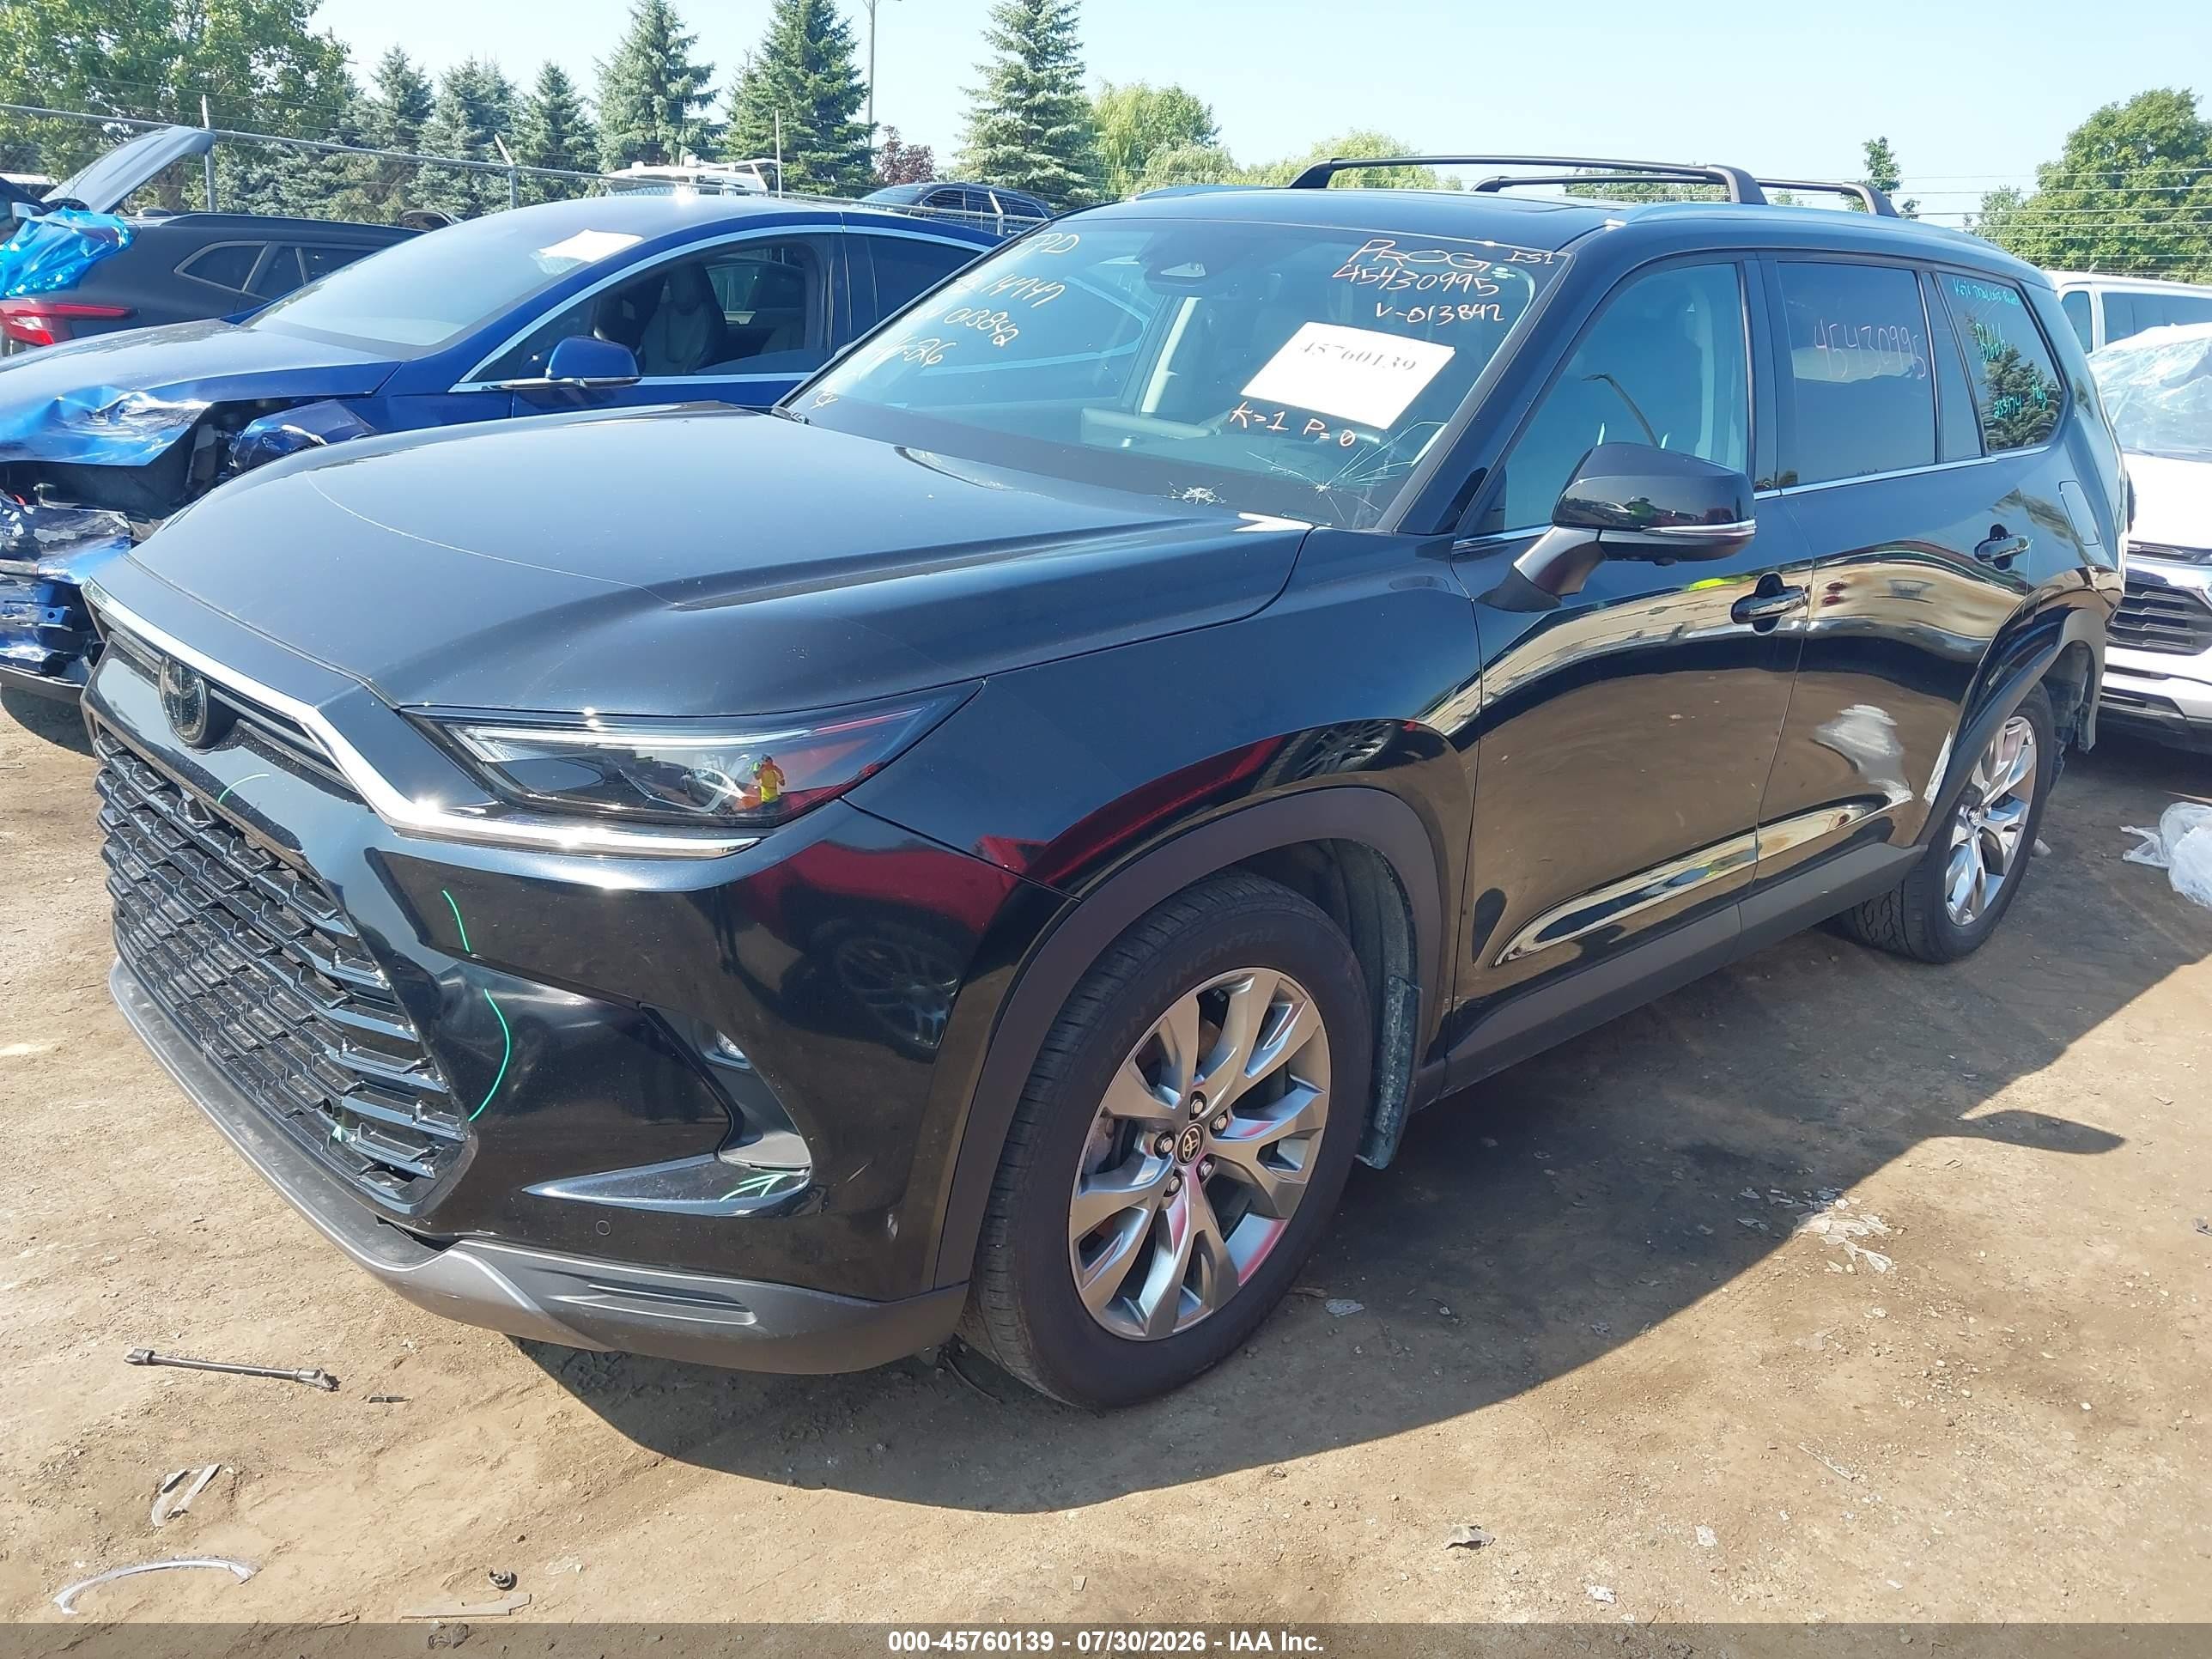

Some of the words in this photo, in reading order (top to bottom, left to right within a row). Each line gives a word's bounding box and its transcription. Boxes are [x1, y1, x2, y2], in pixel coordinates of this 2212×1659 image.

[1332, 264, 1499, 297] 45430995
[1300, 342, 1416, 370] 4560139
[1814, 319, 1926, 380] 45430995
[1230, 401, 1289, 430] K=1
[1303, 418, 1356, 447] P=0
